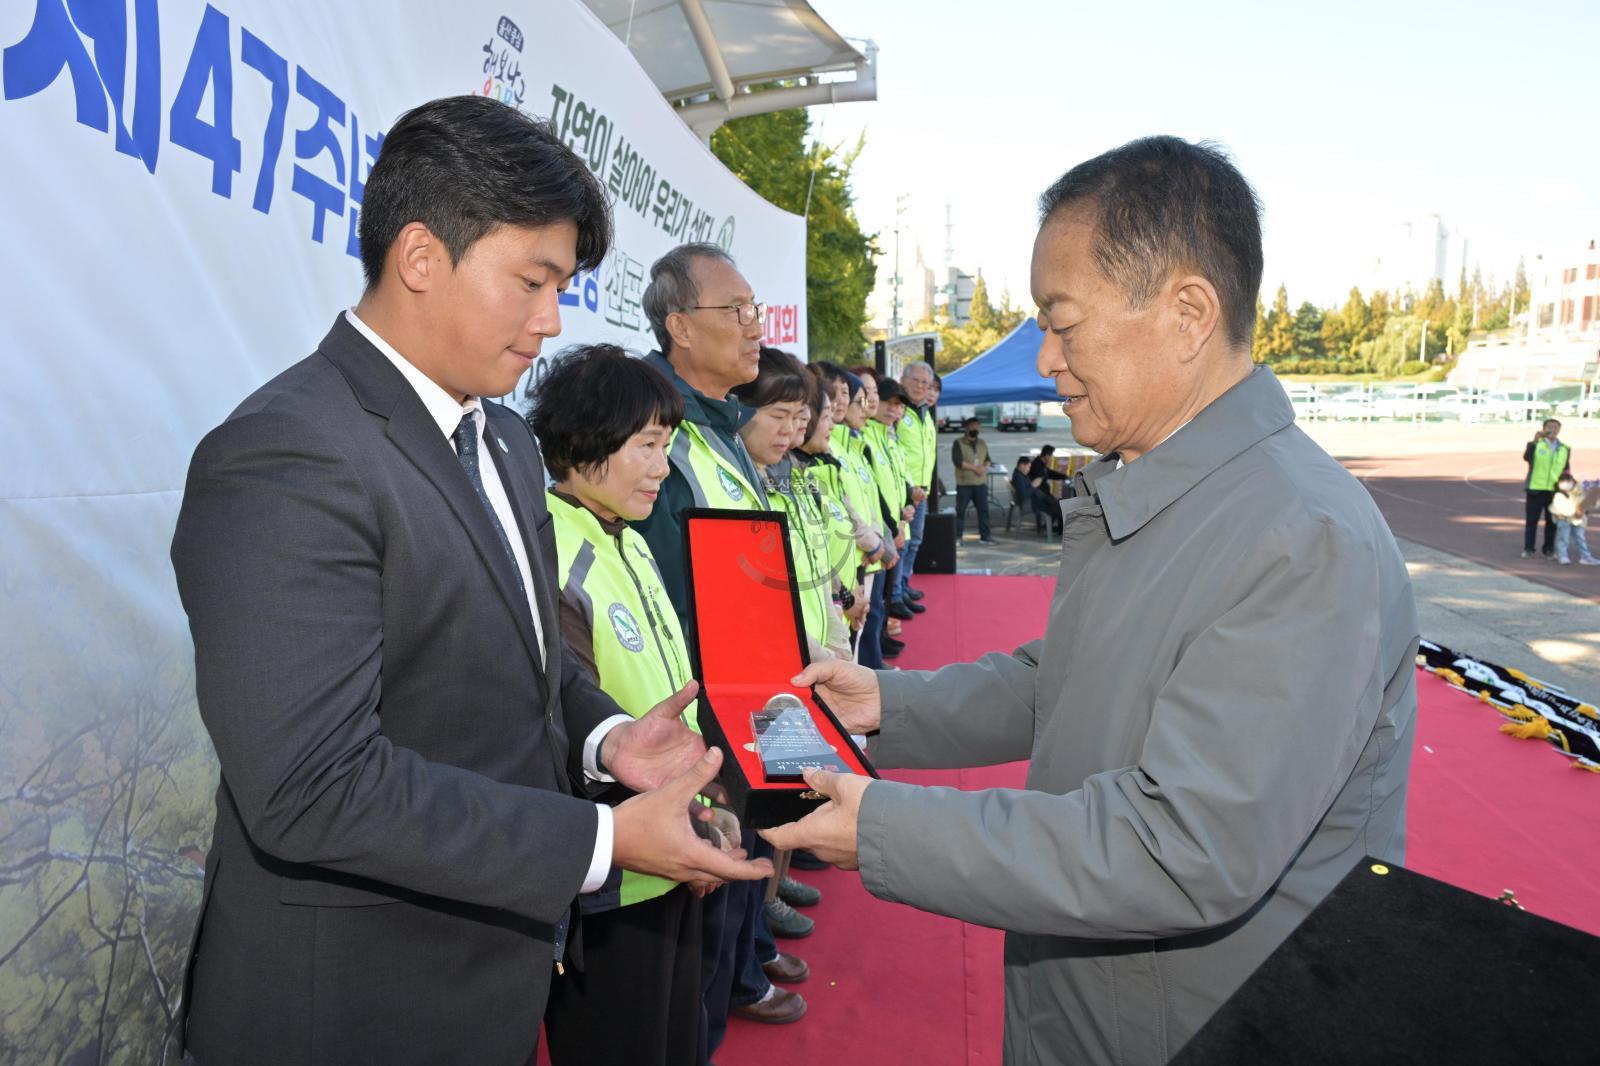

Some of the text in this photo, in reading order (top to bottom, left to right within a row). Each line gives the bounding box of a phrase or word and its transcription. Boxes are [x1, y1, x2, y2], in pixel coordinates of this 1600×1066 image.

[551, 83, 715, 246] 자연이 살아야 우리가 산다
[761, 304, 798, 345] 대회
